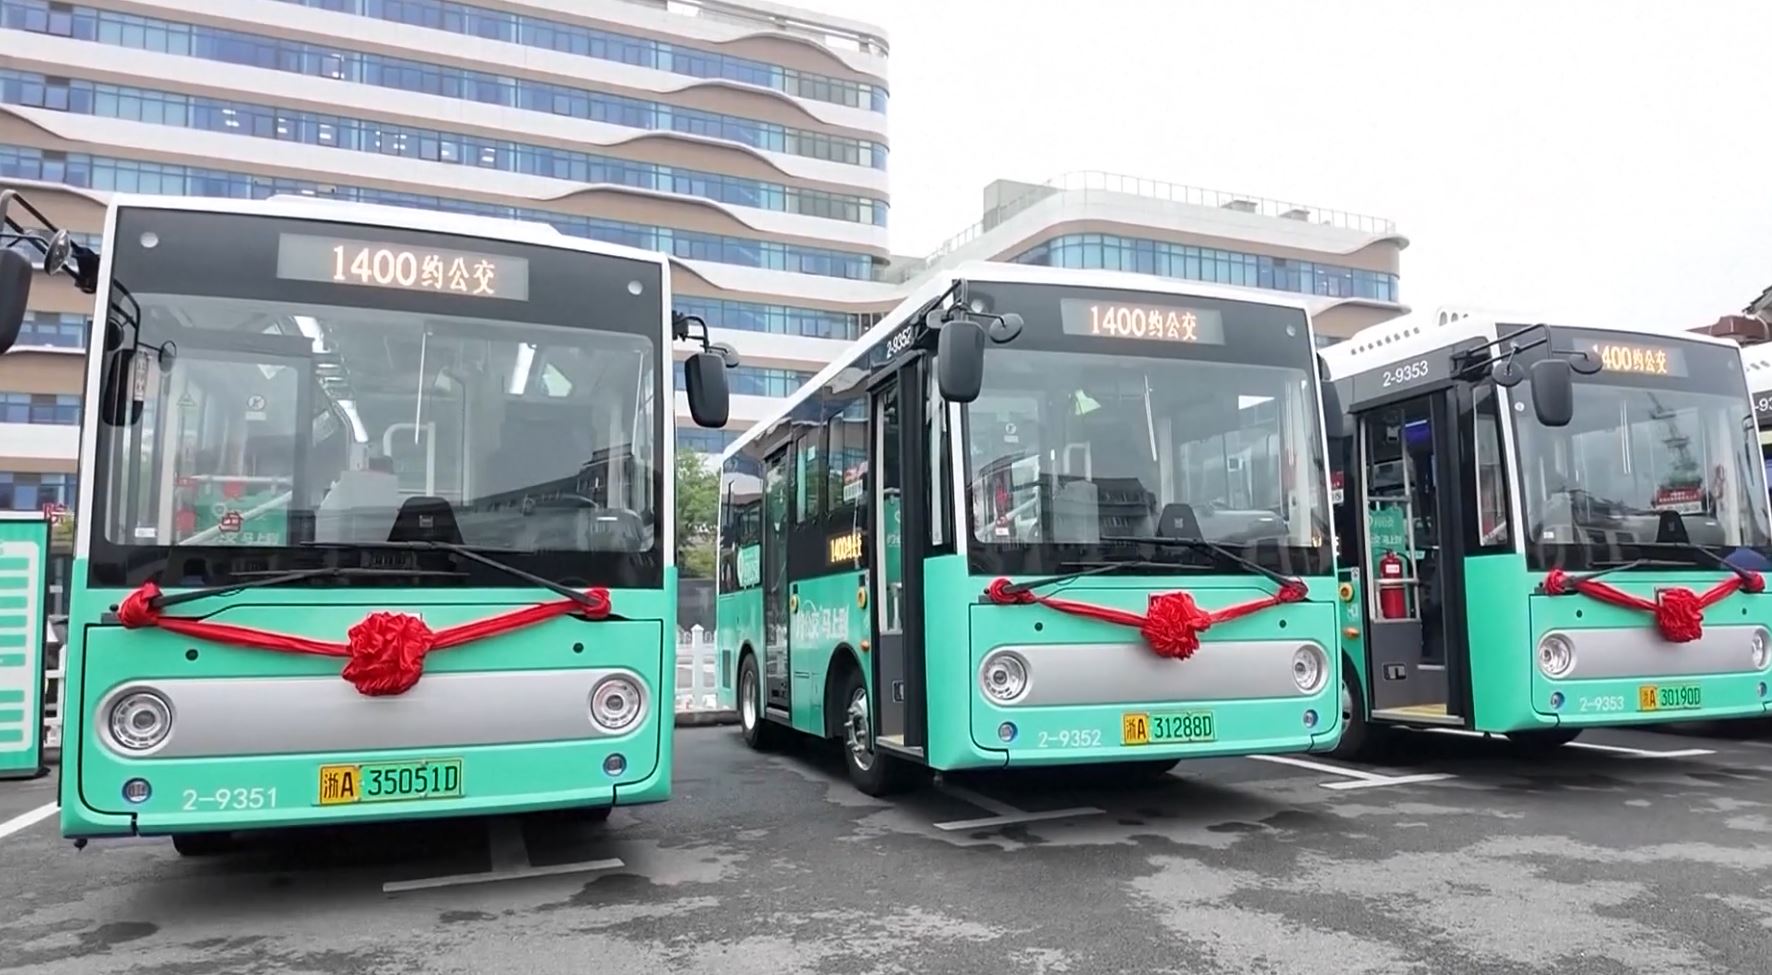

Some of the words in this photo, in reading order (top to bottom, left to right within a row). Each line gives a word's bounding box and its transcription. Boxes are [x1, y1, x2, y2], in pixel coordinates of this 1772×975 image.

[332, 245, 496, 294] 1400约公交
[1089, 305, 1198, 341] 1400约公交
[1383, 360, 1429, 387] 2-9353
[1579, 697, 1625, 712] 2-9353
[1038, 729, 1102, 748] 2-9352
[367, 765, 459, 796] 35051D
[182, 787, 278, 811] 2-9351
